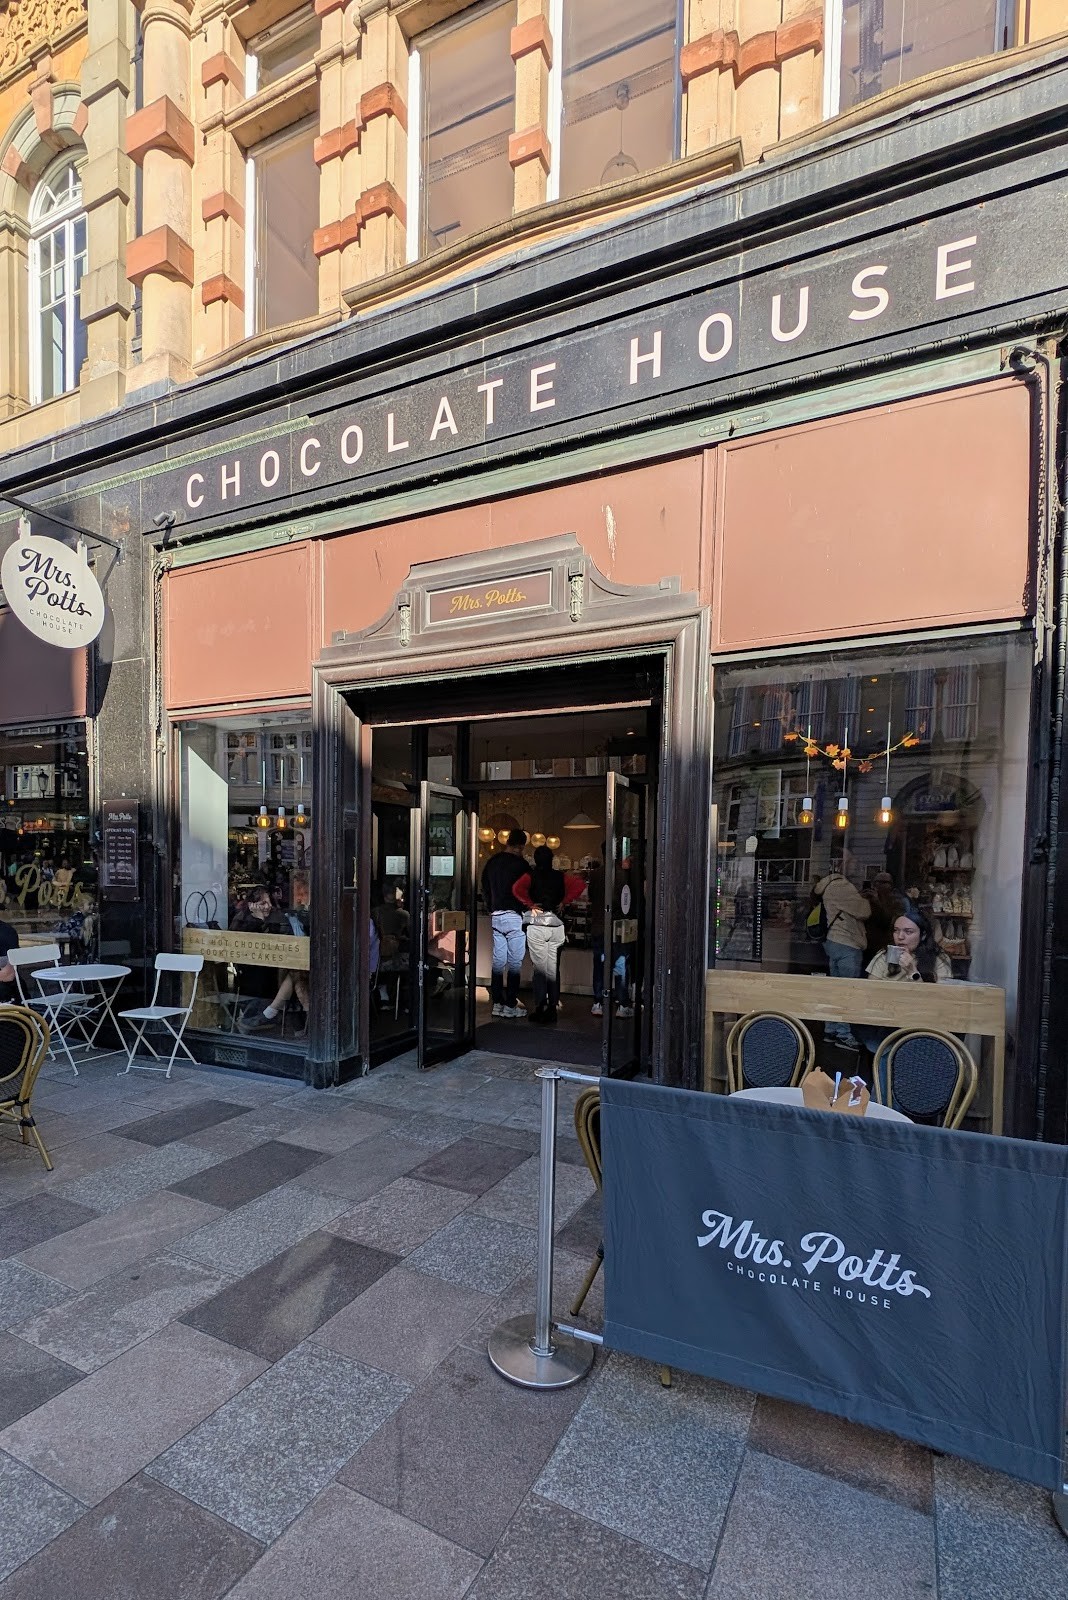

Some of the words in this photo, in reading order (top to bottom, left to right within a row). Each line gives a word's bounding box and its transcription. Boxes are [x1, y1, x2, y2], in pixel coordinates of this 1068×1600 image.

[186, 362, 557, 510] CHOCOLATE
[628, 234, 978, 386] HOUSE
[18, 548, 76, 589] Mrs.
[25, 576, 92, 617] Potts
[450, 594, 483, 614] Mrs.
[485, 587, 527, 608] Potts
[29, 608, 84, 631] CHOCOLATE
[42, 620, 73, 635] HOUSE
[184, 935, 206, 946] EAL
[211, 938, 230, 949] HOT
[234, 939, 301, 953] CHOCOLATES
[200, 947, 242, 959] COOKIES
[251, 951, 285, 963] CAKES
[696, 1209, 792, 1268] Mrs.
[800, 1231, 931, 1299] Potts
[727, 1261, 821, 1292] CHOCOLATE
[833, 1286, 891, 1310] HOUSE
